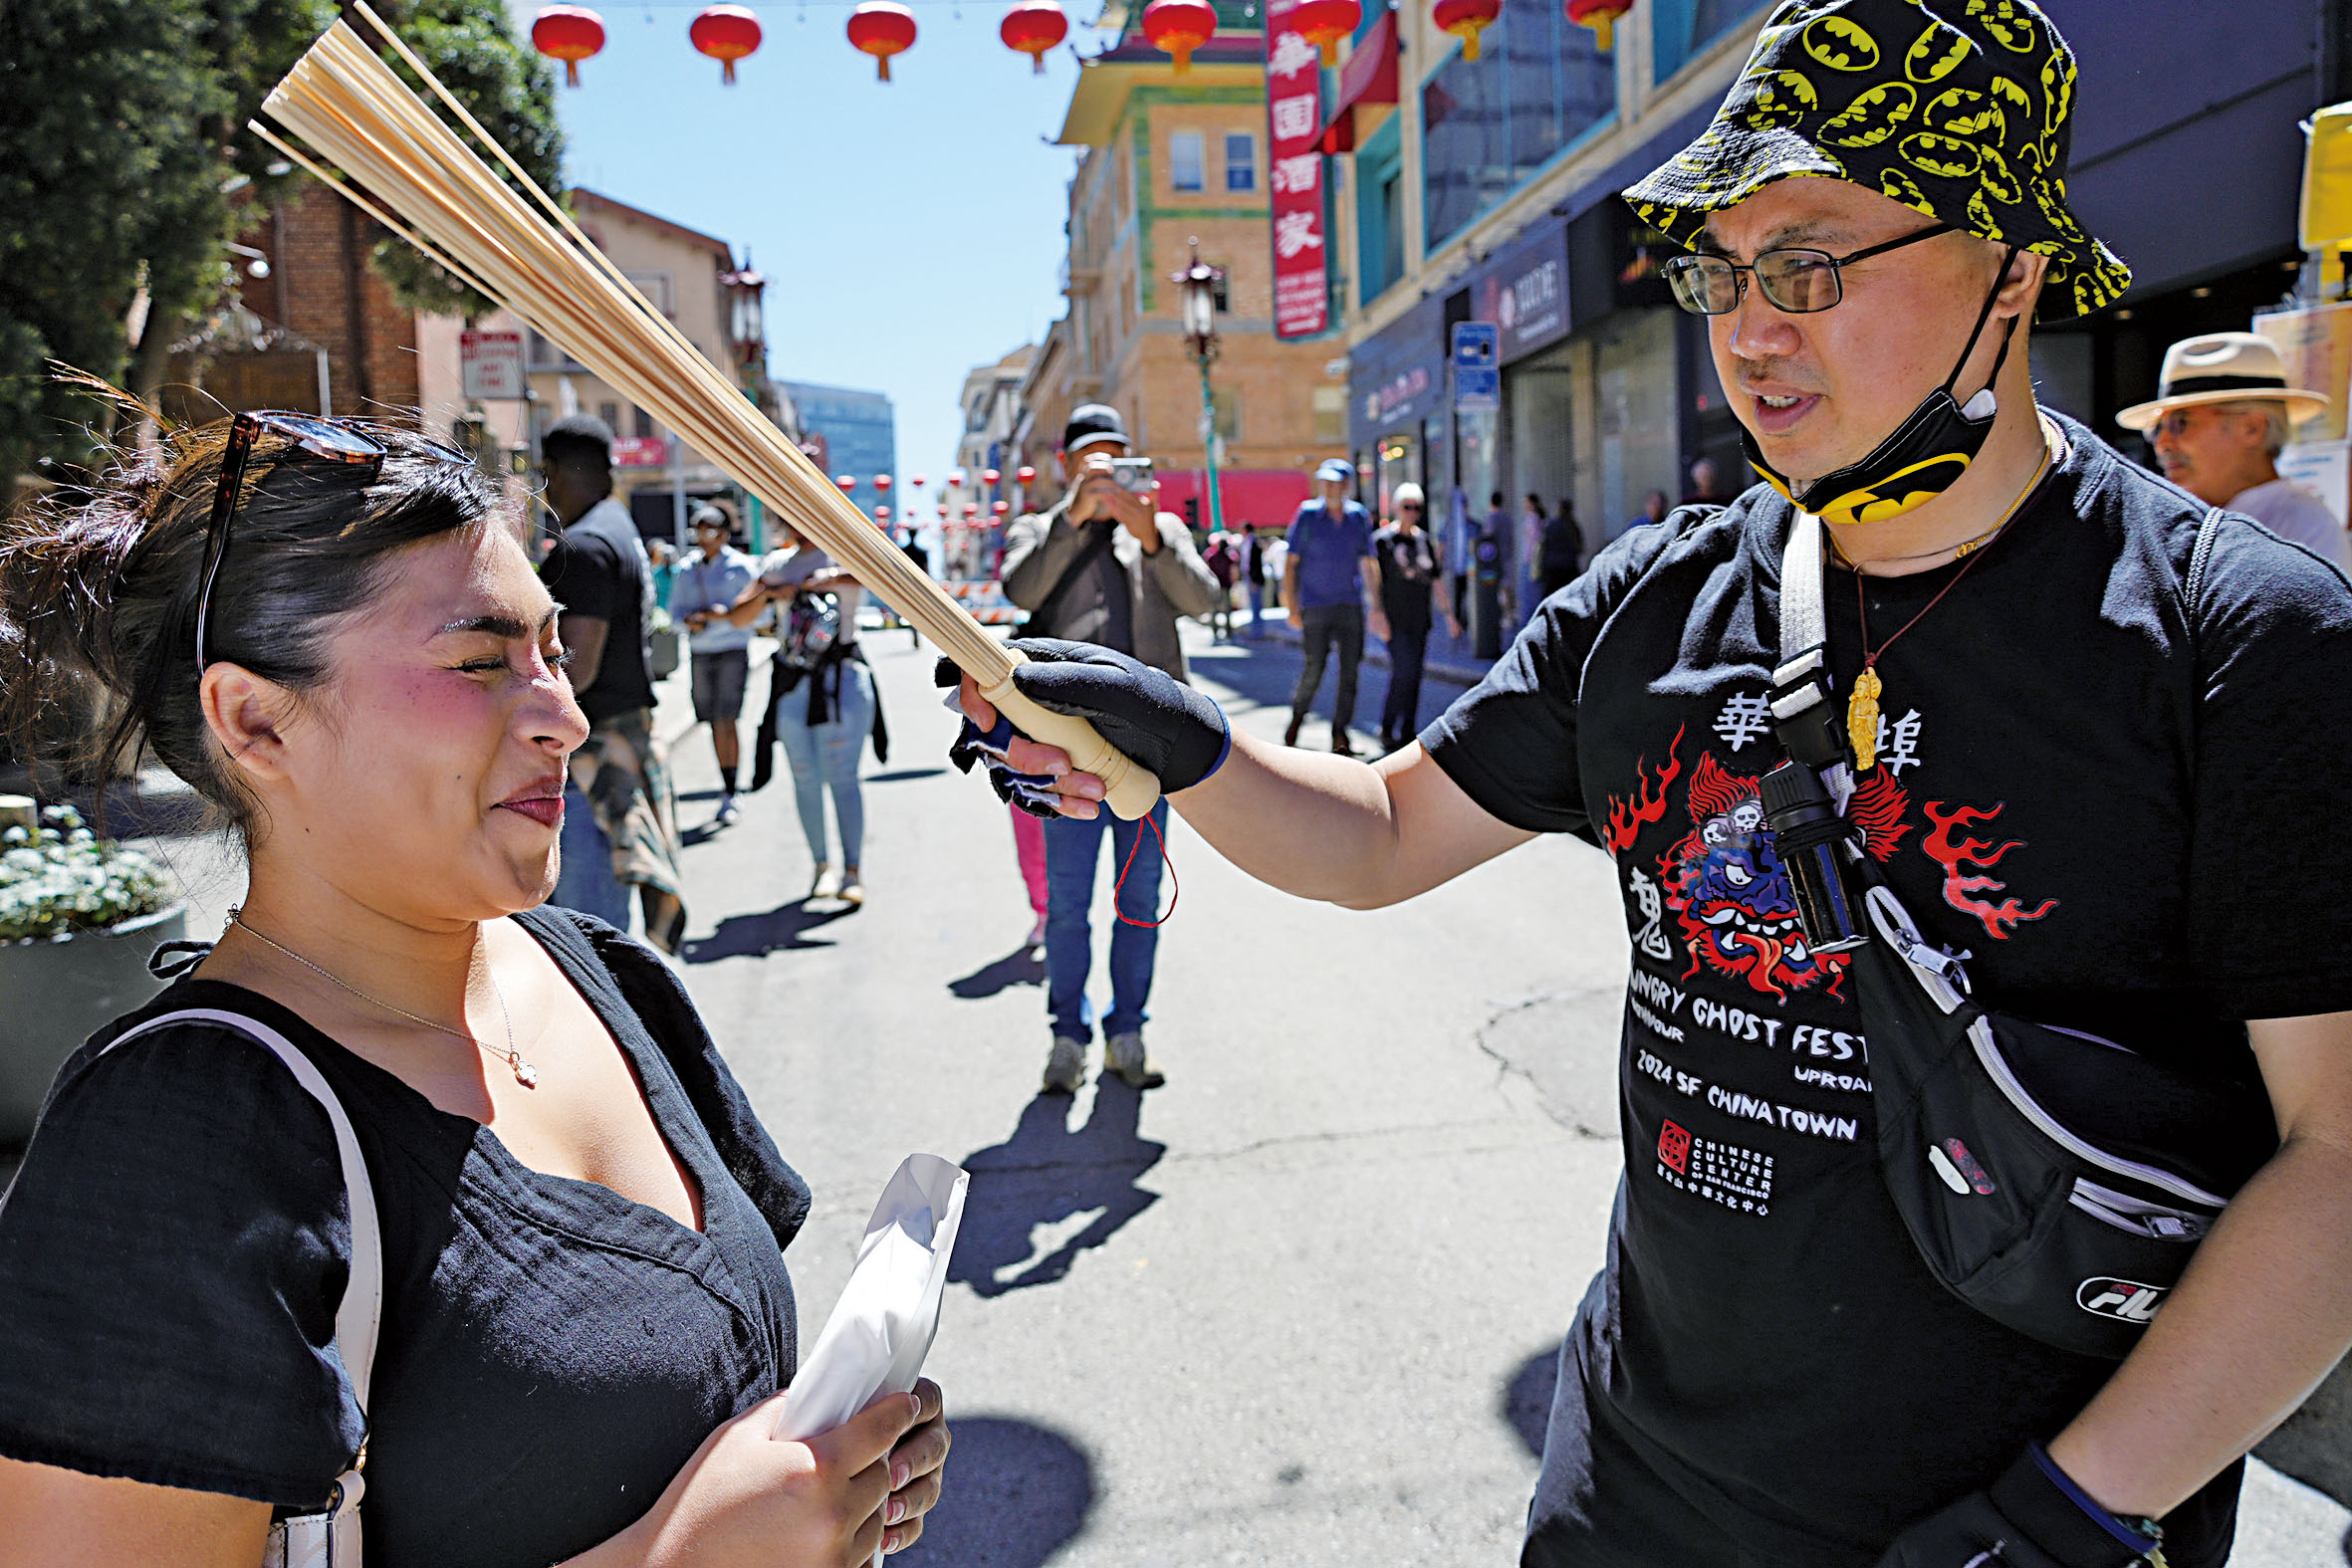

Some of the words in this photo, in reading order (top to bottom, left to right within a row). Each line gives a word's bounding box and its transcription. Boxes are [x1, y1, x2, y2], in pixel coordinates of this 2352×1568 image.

[1631, 969, 1687, 1014] UNGRY
[1693, 997, 1783, 1047] GHOST
[1637, 1049, 1673, 1084] 2024
[1676, 1070, 1703, 1096] SF
[1707, 1084, 1857, 1141] CHINATOWN
[1693, 1149, 1772, 1180] CULTURE
[1694, 1137, 1773, 1168] CHINESE
[1692, 1161, 1771, 1193] CENTER
[1705, 1175, 1722, 1186] SAN
[1722, 1180, 1769, 1200] FRANCISCO
[2087, 1283, 2164, 1321] FIL
